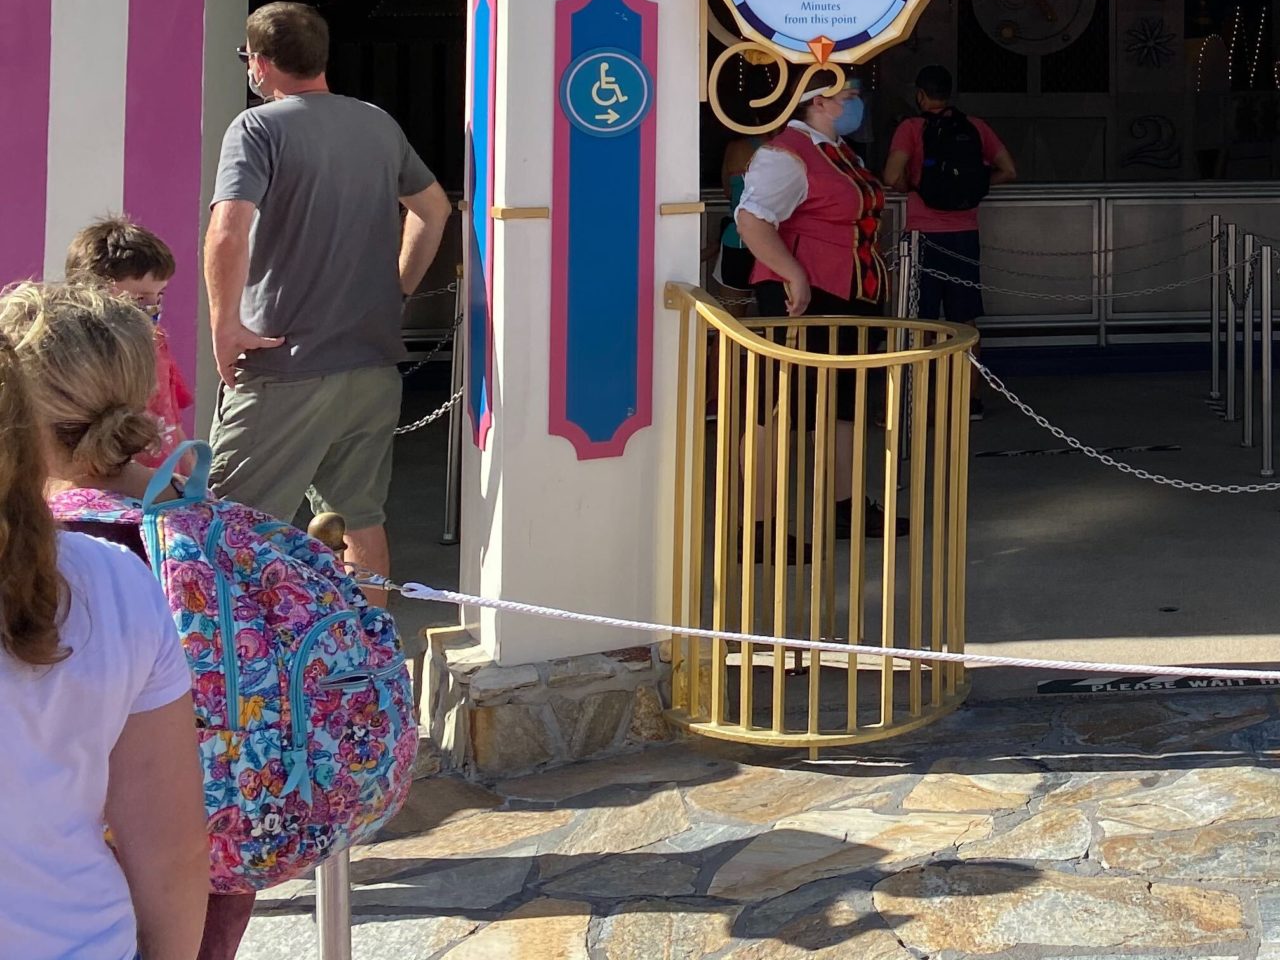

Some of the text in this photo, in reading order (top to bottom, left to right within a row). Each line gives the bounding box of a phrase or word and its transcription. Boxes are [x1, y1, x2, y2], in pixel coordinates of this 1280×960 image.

[800, 1, 841, 12] Minutes
[784, 14, 857, 27] from this point
[1091, 680, 1177, 692] PLEASE
[1188, 677, 1248, 688] WAIT
